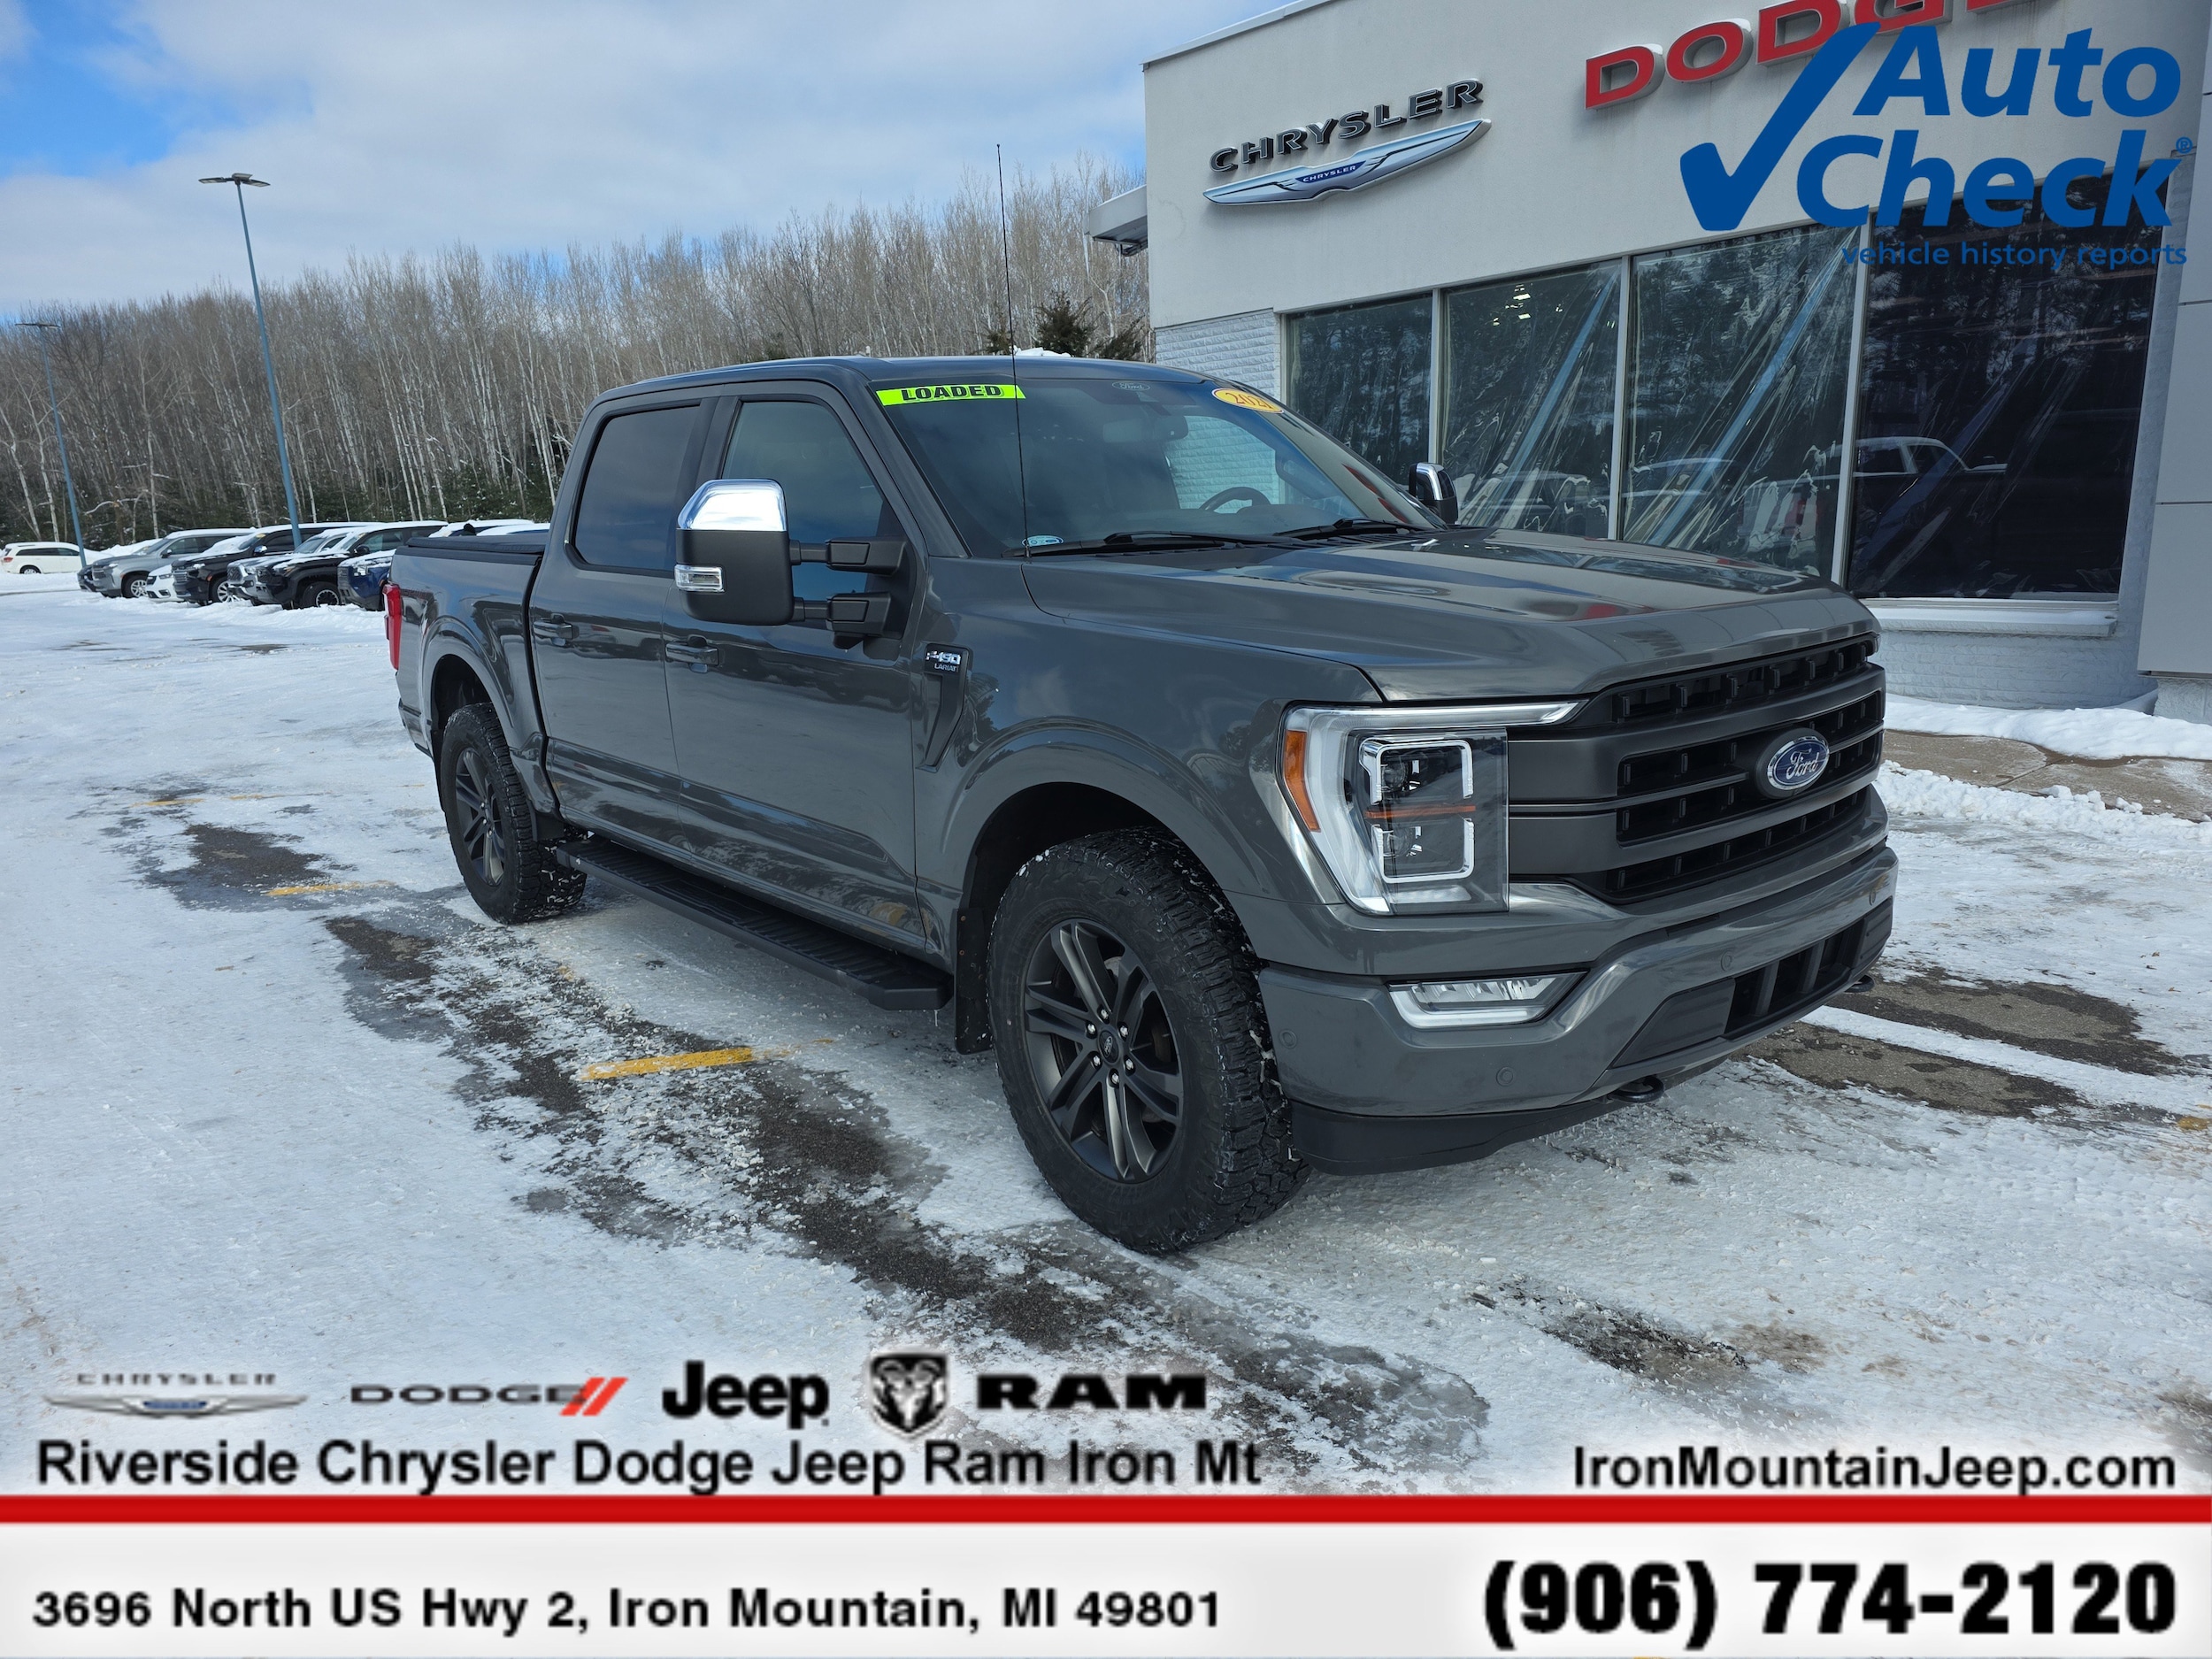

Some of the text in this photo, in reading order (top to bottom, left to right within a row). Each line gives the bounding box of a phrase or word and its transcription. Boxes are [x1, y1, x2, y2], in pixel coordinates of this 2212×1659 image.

[1585, 0, 2026, 111] DODG
[1210, 78, 1483, 173] CHRYSLER
[1302, 165, 1356, 182] CHRYSLER
[901, 385, 1003, 402] LOADED
[926, 650, 962, 665] F-150
[933, 663, 957, 672] LARIAT
[1786, 748, 1820, 780] Ford
